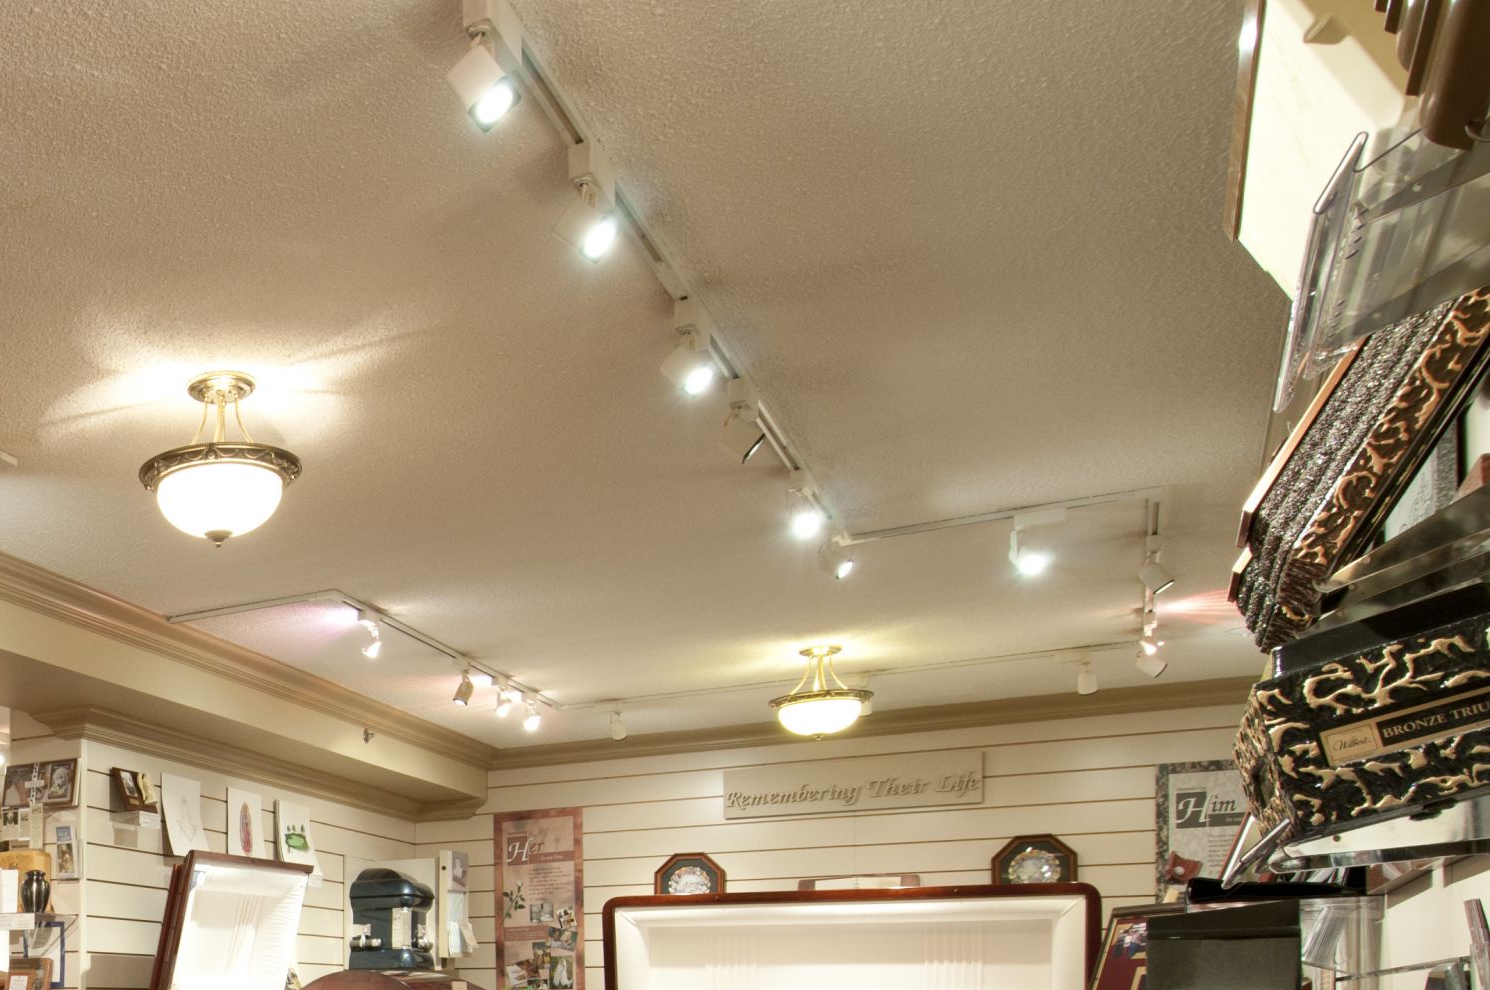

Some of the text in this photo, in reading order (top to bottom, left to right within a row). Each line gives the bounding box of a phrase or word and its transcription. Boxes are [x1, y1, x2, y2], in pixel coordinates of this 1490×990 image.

[1381, 712, 1447, 739] BRONZE
[726, 769, 980, 810] Remembering Their Life
[1174, 794, 1237, 824] Him
[506, 837, 545, 863] Her
